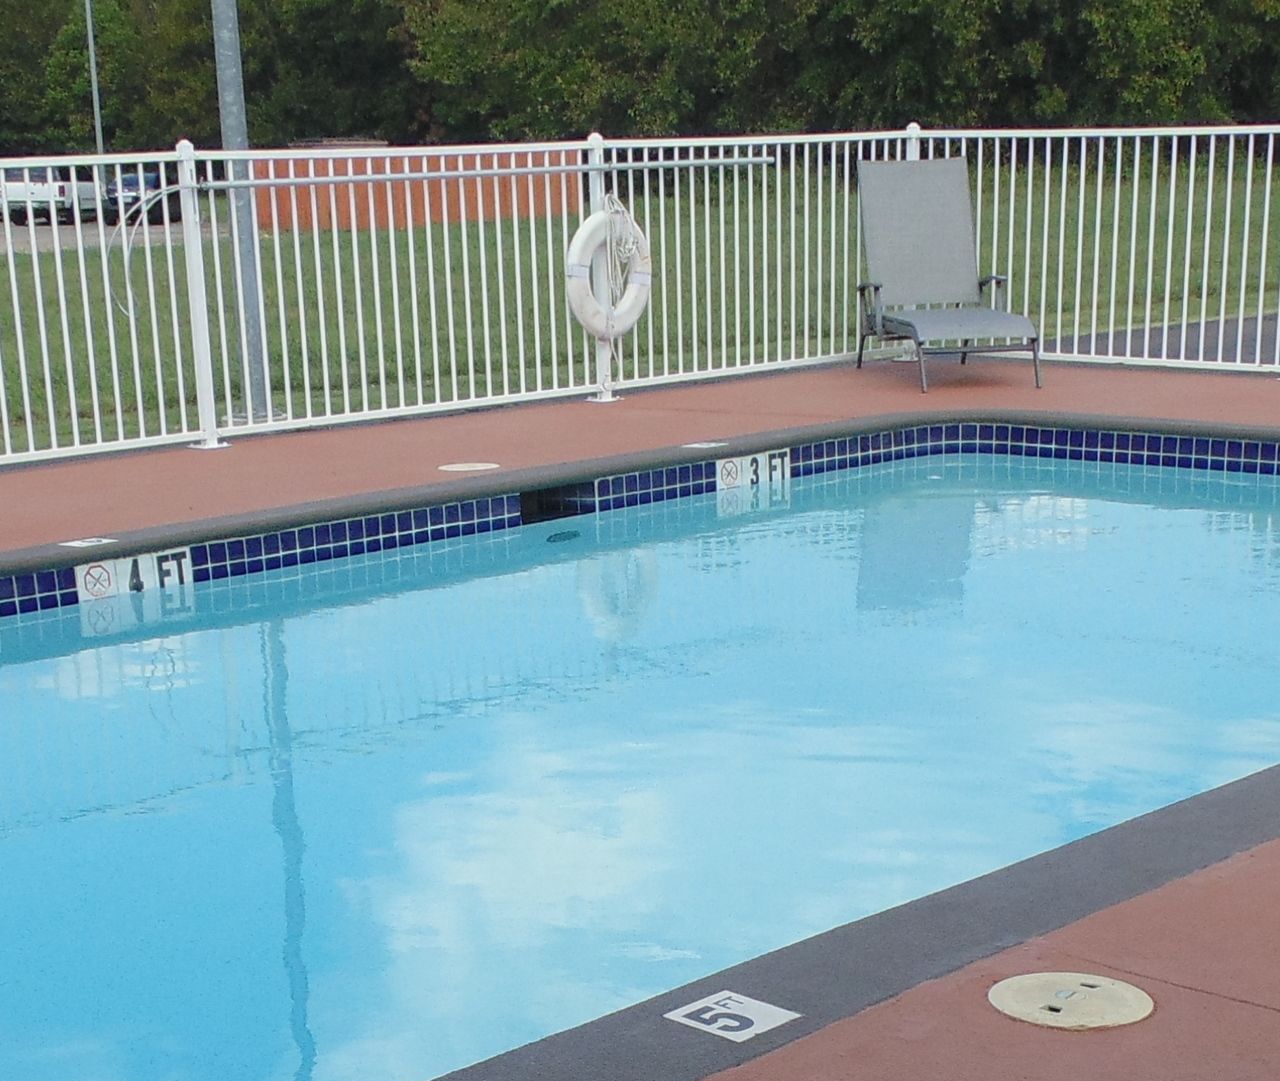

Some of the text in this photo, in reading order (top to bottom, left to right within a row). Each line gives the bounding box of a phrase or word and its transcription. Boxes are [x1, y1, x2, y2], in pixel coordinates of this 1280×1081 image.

[750, 451, 788, 485] 3 FT
[129, 551, 187, 592] 4 FT
[681, 996, 754, 1032] 5 FT
